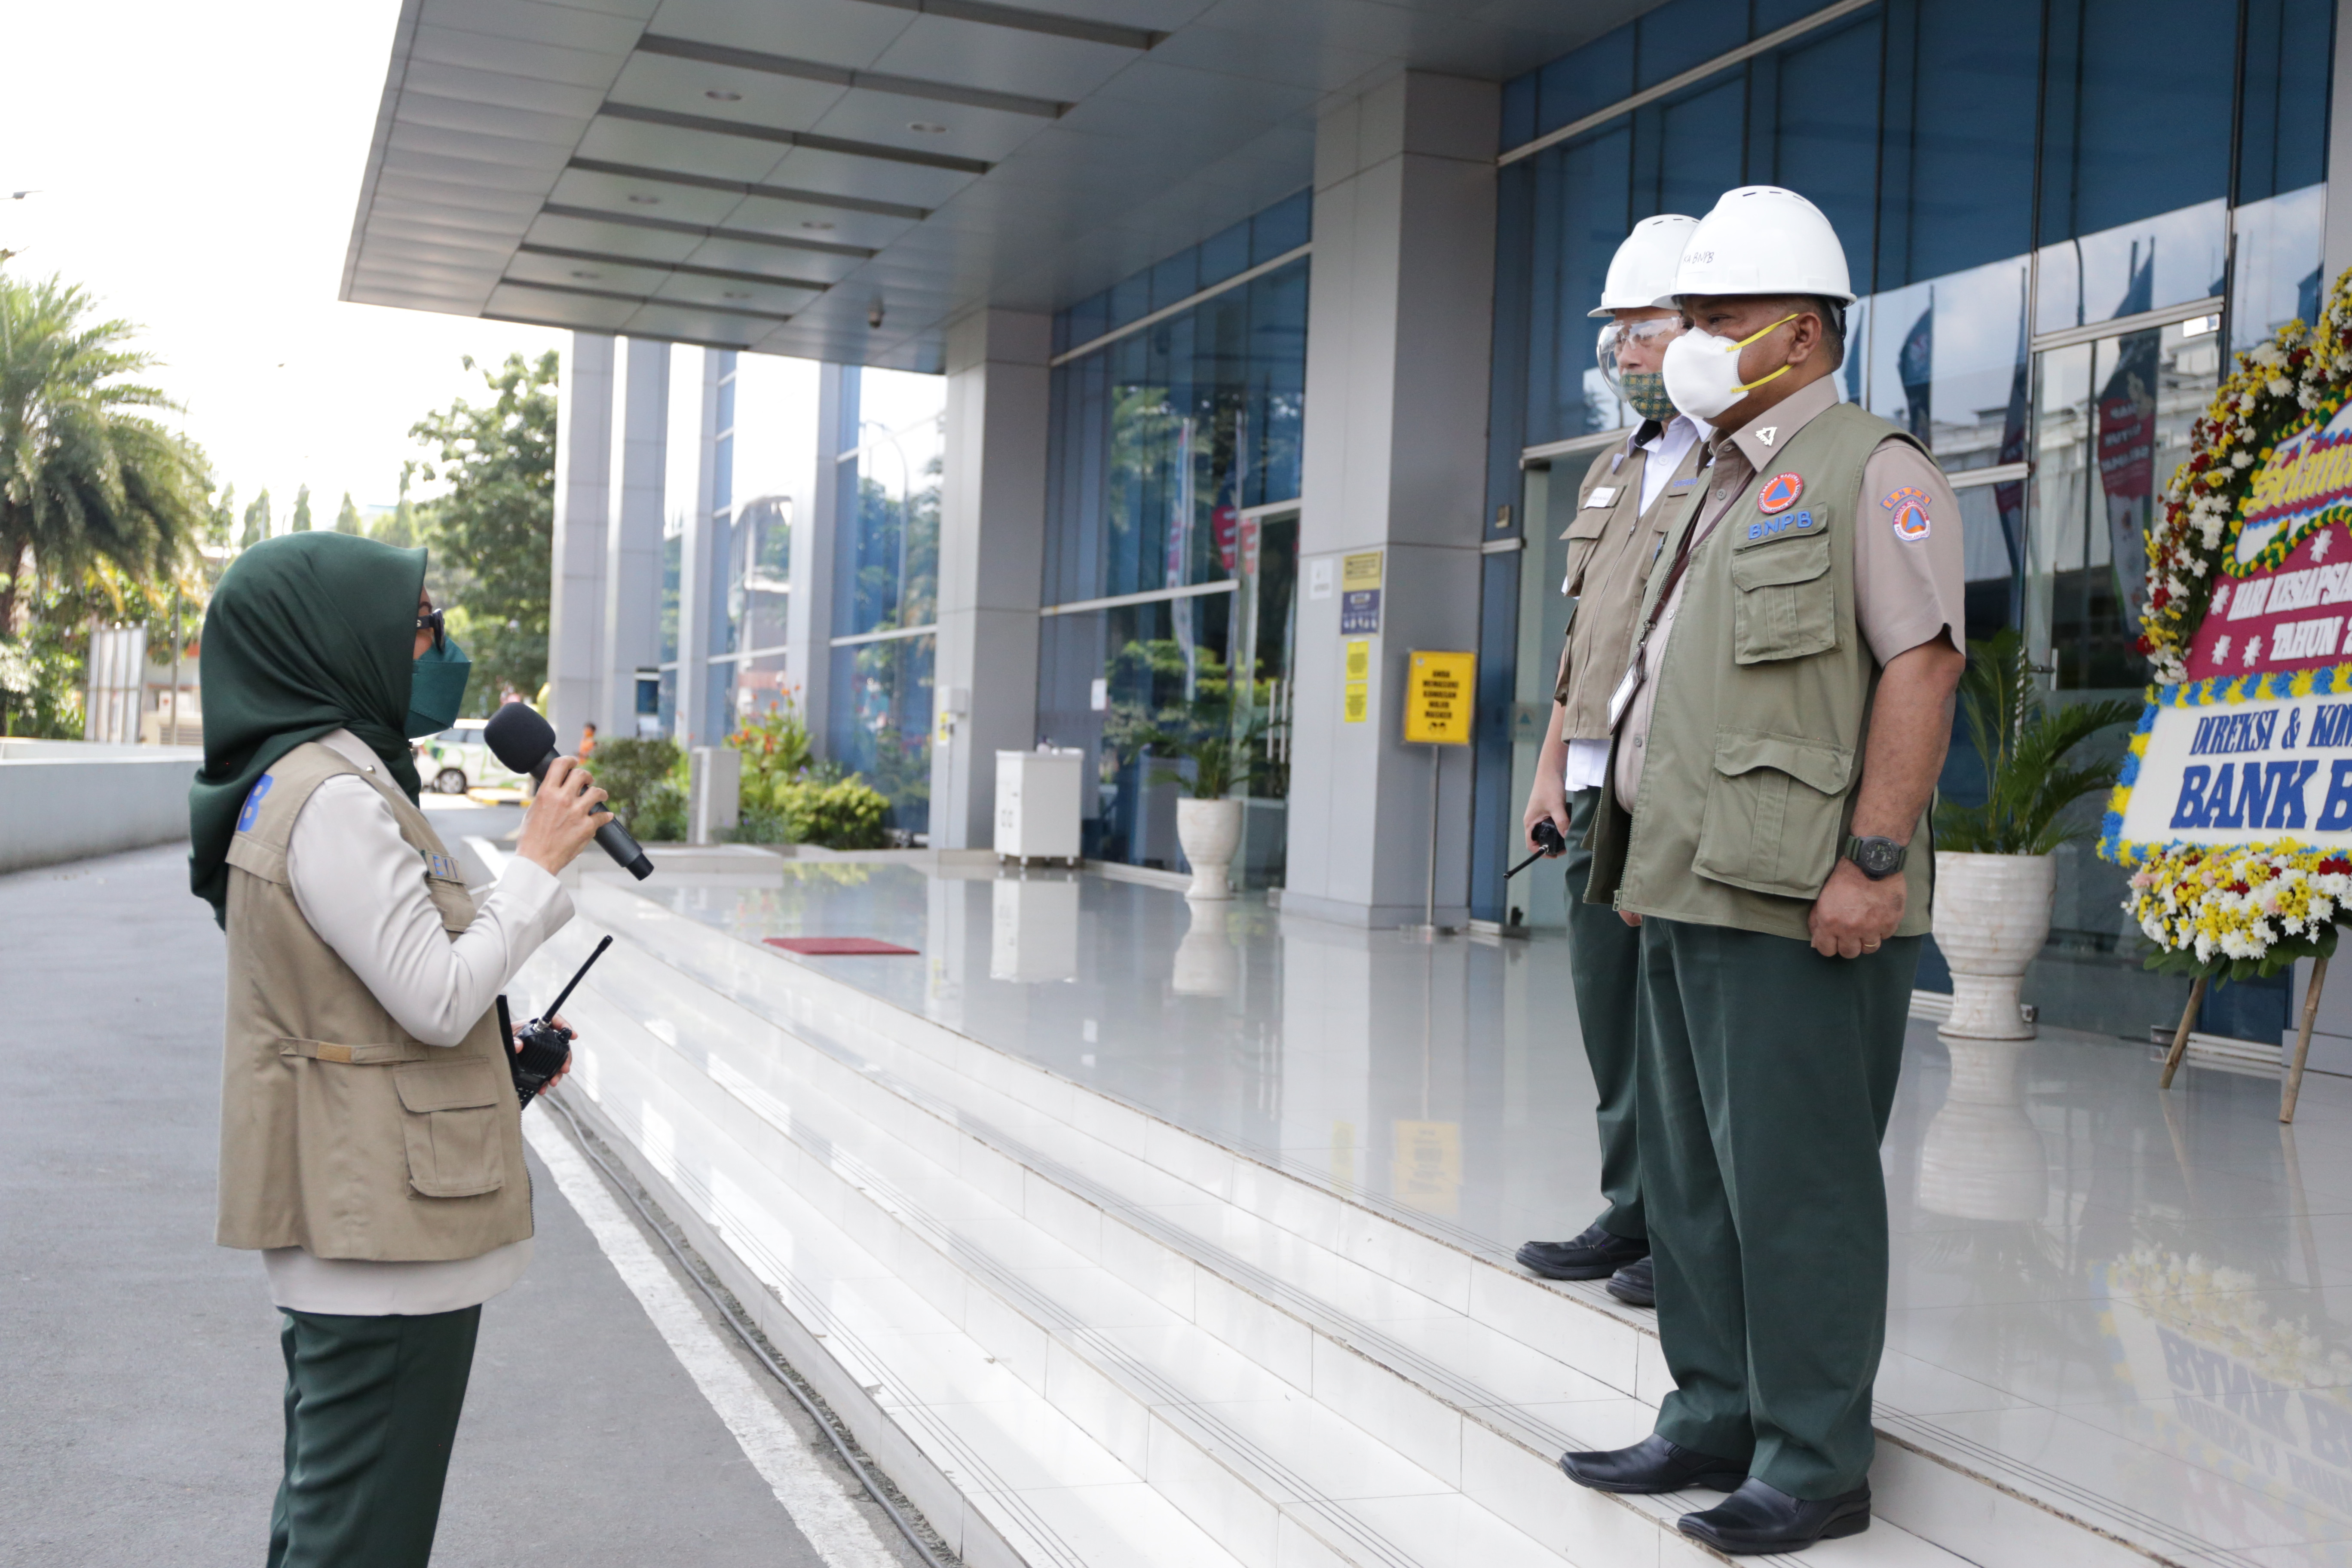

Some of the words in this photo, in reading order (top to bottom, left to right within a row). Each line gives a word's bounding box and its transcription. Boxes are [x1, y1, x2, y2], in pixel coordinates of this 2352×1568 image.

[1683, 254, 1690, 264] KA
[1692, 251, 1714, 263] BNPB
[1762, 477, 1778, 492] BADAN
[1780, 473, 1800, 484] NASIONAL
[1887, 489, 1926, 504] BNPB
[1760, 494, 1785, 511] PENANGGULANGAN
[1749, 511, 1813, 539] BNPB
[2227, 577, 2274, 622] HARI
[2269, 616, 2344, 661] TAHUN
[2189, 709, 2279, 755] DIREKSI
[2281, 707, 2300, 749] &
[2169, 759, 2319, 829] BANK
[2315, 759, 2352, 831] B
